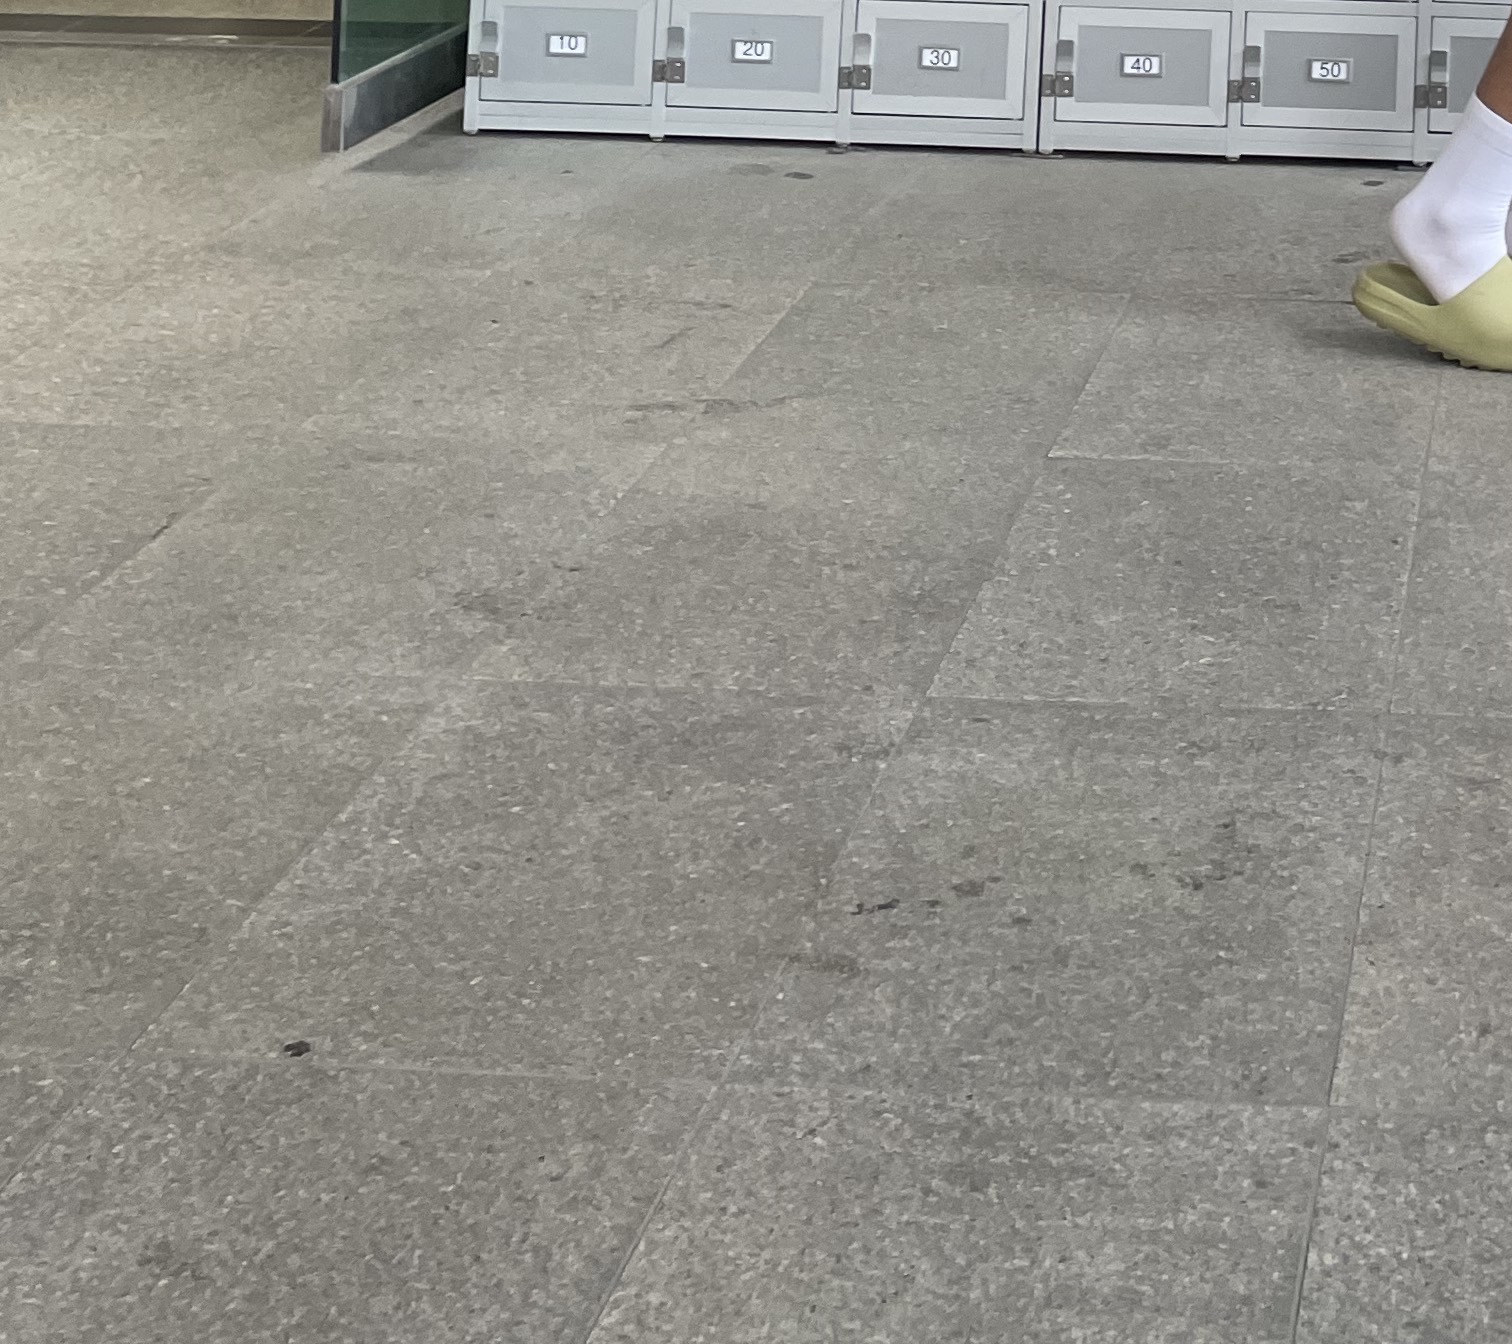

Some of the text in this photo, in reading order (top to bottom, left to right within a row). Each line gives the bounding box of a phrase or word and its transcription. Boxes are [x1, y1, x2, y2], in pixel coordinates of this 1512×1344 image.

[559, 36, 578, 50] 10
[743, 42, 764, 57] 20
[930, 50, 951, 66] 30
[1131, 57, 1152, 72] 40
[1320, 62, 1341, 78] 50
